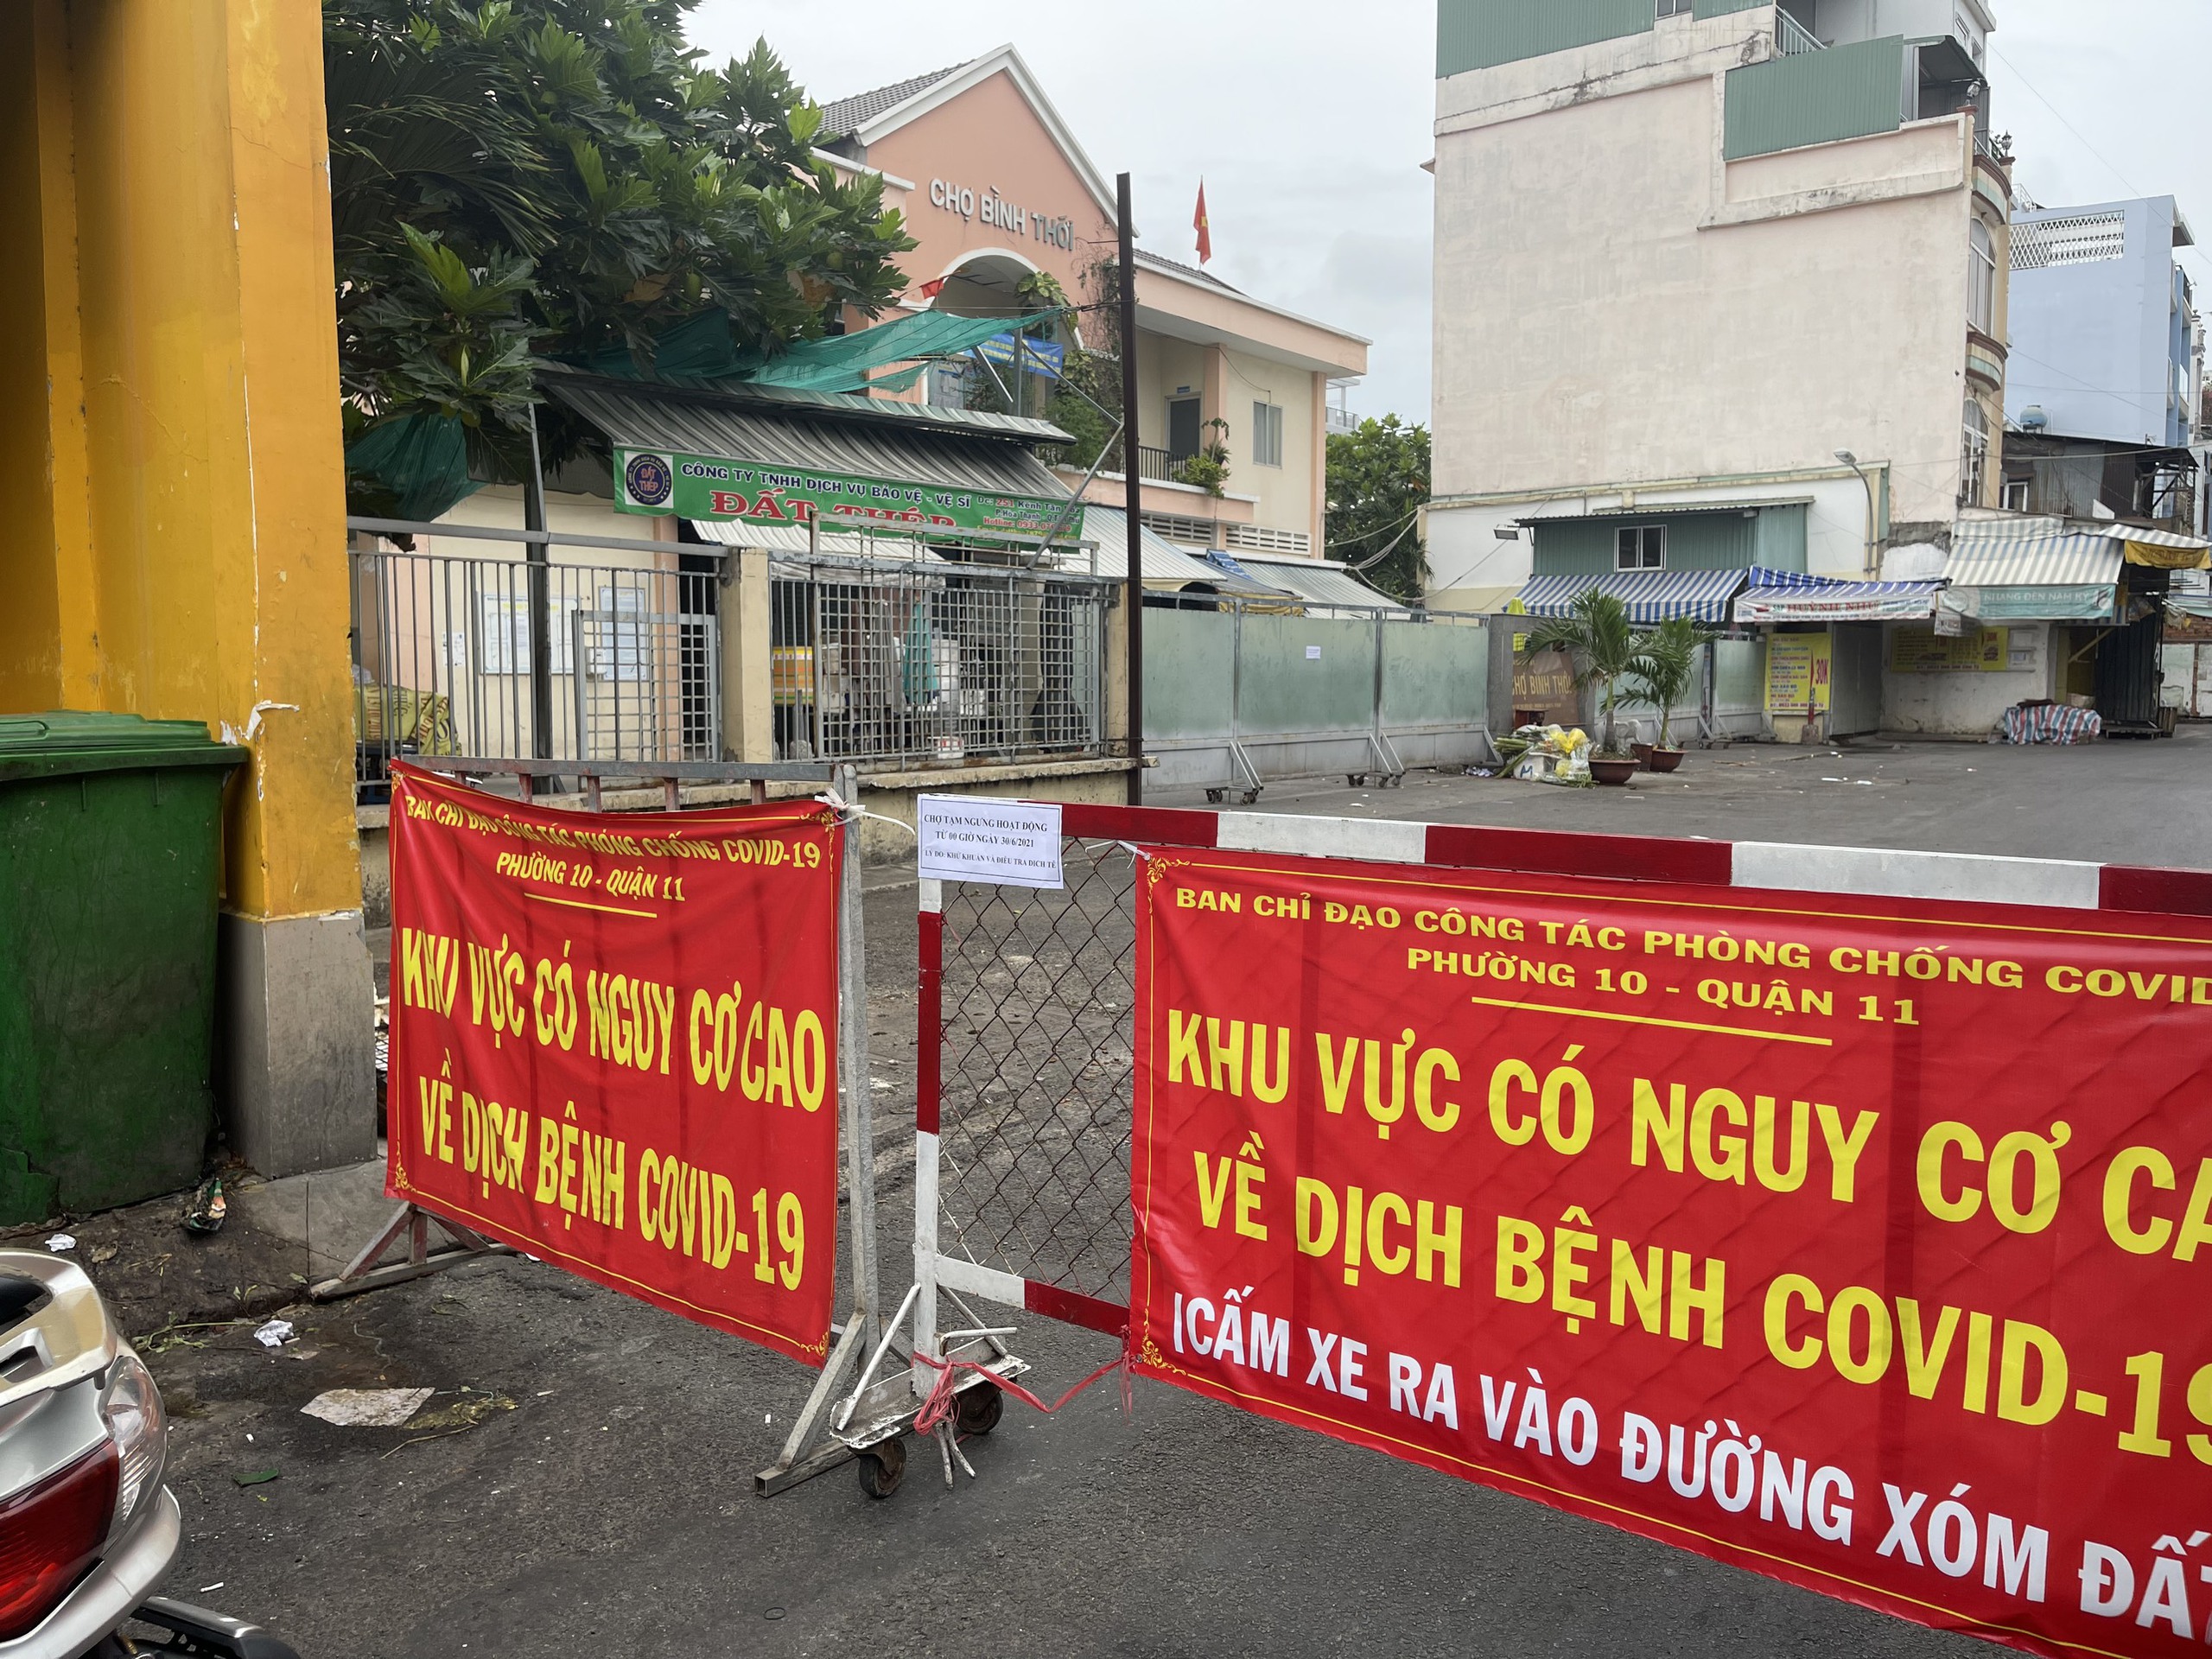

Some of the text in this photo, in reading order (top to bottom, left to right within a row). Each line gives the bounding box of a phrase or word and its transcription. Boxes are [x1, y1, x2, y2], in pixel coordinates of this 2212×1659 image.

[930, 178, 974, 222] CHỢ
[980, 185, 1026, 235] BÌNH
[682, 461, 728, 480] CÔNG
[734, 469, 753, 482] TY
[759, 472, 801, 488] TNHH
[806, 478, 842, 493] DỊCH
[847, 483, 865, 497] VỤ
[872, 484, 899, 500] BẢO
[905, 488, 922, 503] VỆ
[936, 493, 952, 507] VỆ
[957, 495, 971, 508] SĨ
[709, 487, 957, 527] ĐẤT THÉP
[996, 498, 1014, 507] 251
[983, 517, 1015, 526] Hotline:
[1512, 672, 1527, 701] HỢ
[1529, 670, 1550, 695] BÌNH
[404, 795, 435, 822] BAN
[494, 813, 543, 842] CÔNG
[536, 823, 577, 848] TÁC
[641, 830, 721, 861] CHỐNG
[722, 839, 821, 869] COVID-19
[924, 814, 943, 825] CHỢ
[944, 815, 962, 826] TẠM
[996, 819, 1020, 831] HOẠT
[1022, 821, 1047, 833] ĐỘNG
[935, 829, 949, 840] TỪ
[958, 830, 975, 842] GIỜ
[976, 832, 1000, 844] NGÀY
[1001, 836, 1034, 848] 30/6/2021
[496, 851, 568, 886] PHƯỜNG
[569, 864, 594, 889] 10
[606, 865, 658, 901] QUẬN
[662, 876, 686, 901] 11
[986, 854, 995, 863] VÀ
[1014, 858, 1027, 867] TRA
[1176, 887, 1242, 913] BAN
[1253, 892, 1312, 921] CHỈ
[1324, 901, 1402, 931] ĐẠO
[1414, 907, 1524, 942] CÔNG
[1538, 918, 1626, 951] TÁC
[1643, 929, 1811, 970] PHÒNG
[1829, 945, 2024, 989] CHỐNG
[1407, 947, 1576, 988] PHƯỜNG
[1595, 969, 1648, 995] 10
[1696, 978, 1834, 1016] QUẬN
[1858, 995, 1920, 1027] 11
[401, 927, 827, 1113] KHU VỰC CÓ NGUY CƠ CAO
[1167, 1008, 1291, 1104] KHU
[1315, 1027, 1461, 1141] VỰC
[1488, 1045, 1595, 1156] CÓ
[1630, 1077, 1880, 1204] NGUY
[1916, 1121, 2072, 1235] CƠ
[419, 1046, 805, 1292] VỀ DỊCH BỆNH COVID-19
[1193, 1130, 1268, 1242] VỀ
[1295, 1176, 1463, 1288] DỊCH
[1495, 1205, 1726, 1350] BỆNH
[1306, 1327, 1369, 1402] XE
[1389, 1352, 1459, 1431] RA
[1479, 1368, 1599, 1467] VÀO
[1619, 1418, 1856, 1547] ĐƯỜNG
[1875, 1483, 2050, 1603] XÓM
[2078, 1529, 2212, 1646] ĐẤ
